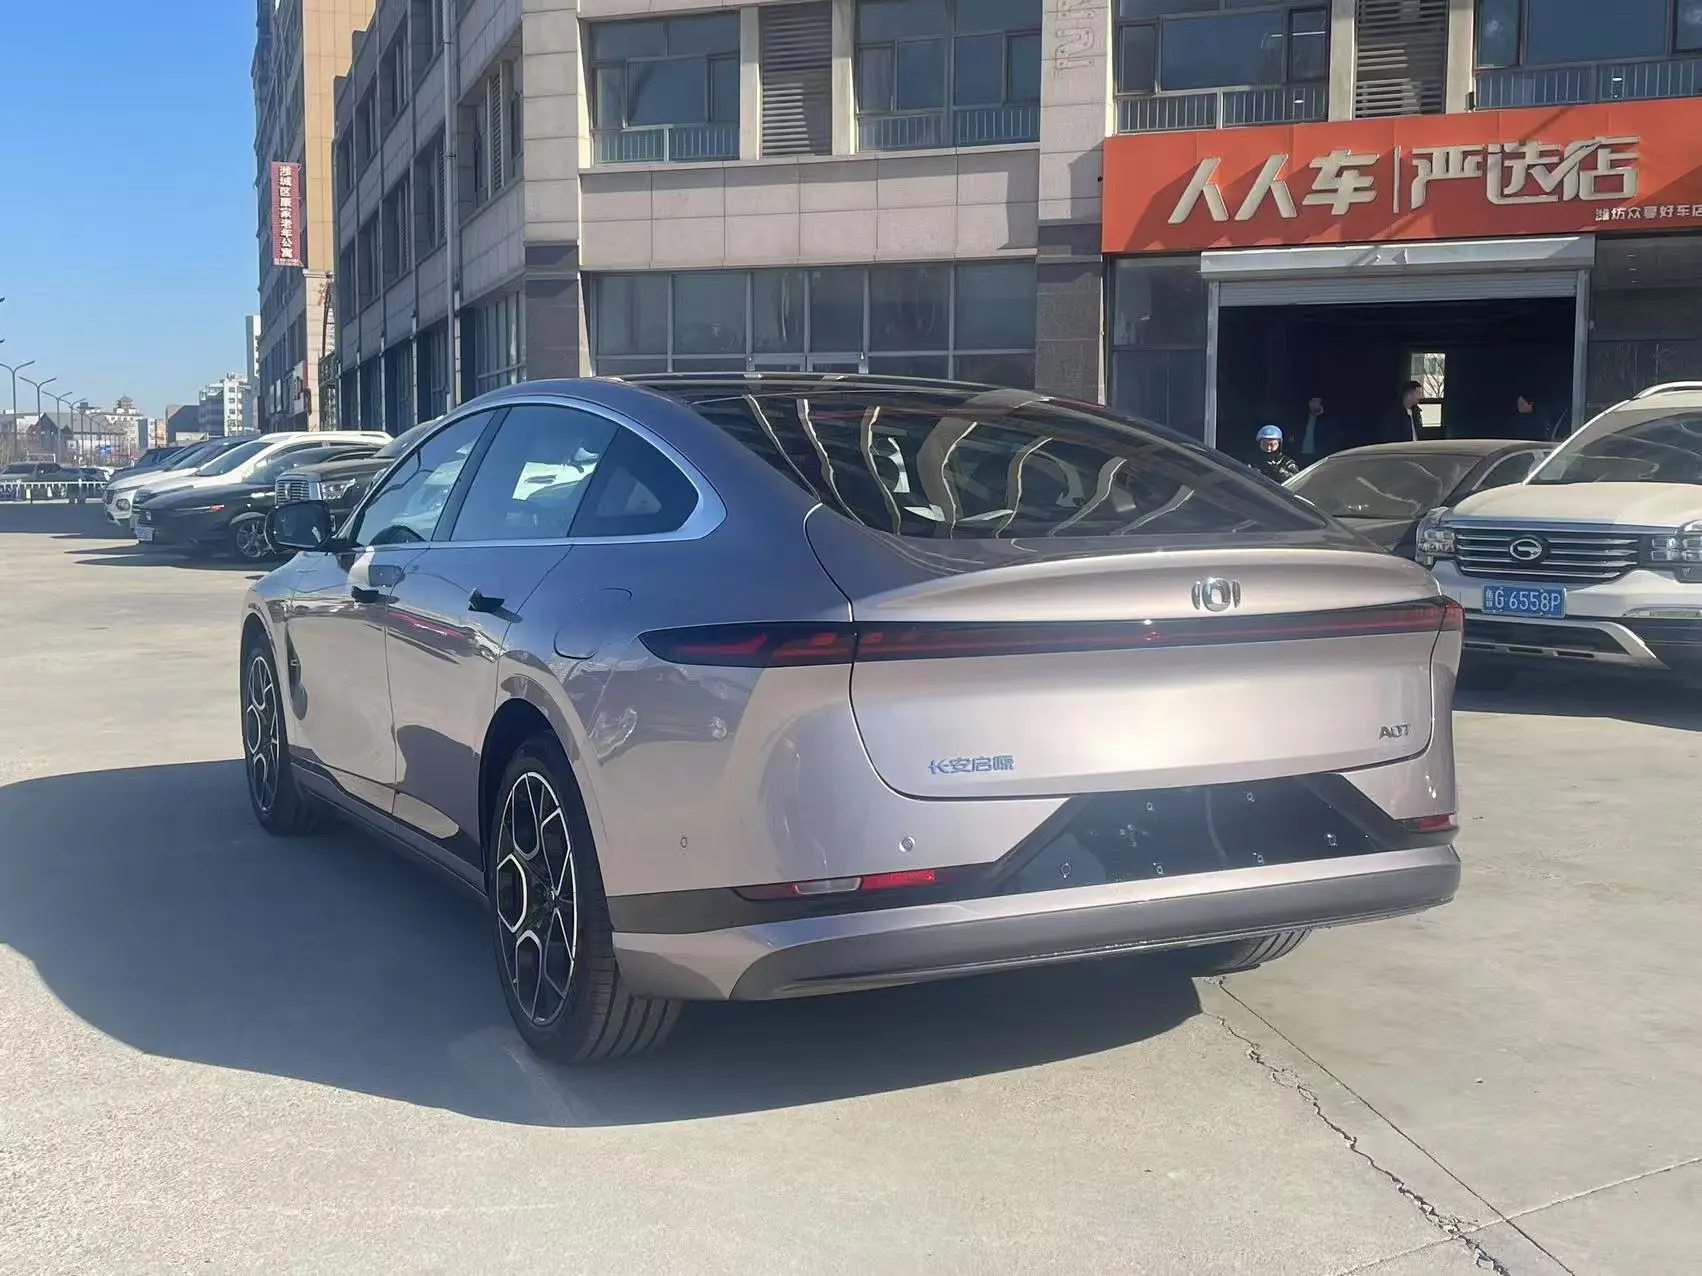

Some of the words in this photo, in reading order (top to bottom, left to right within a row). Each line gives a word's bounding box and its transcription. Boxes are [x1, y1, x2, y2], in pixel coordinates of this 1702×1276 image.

[1167, 148, 1379, 224] 人人车
[1410, 136, 1641, 210] 严选店
[928, 755, 1014, 775] 长安启源
